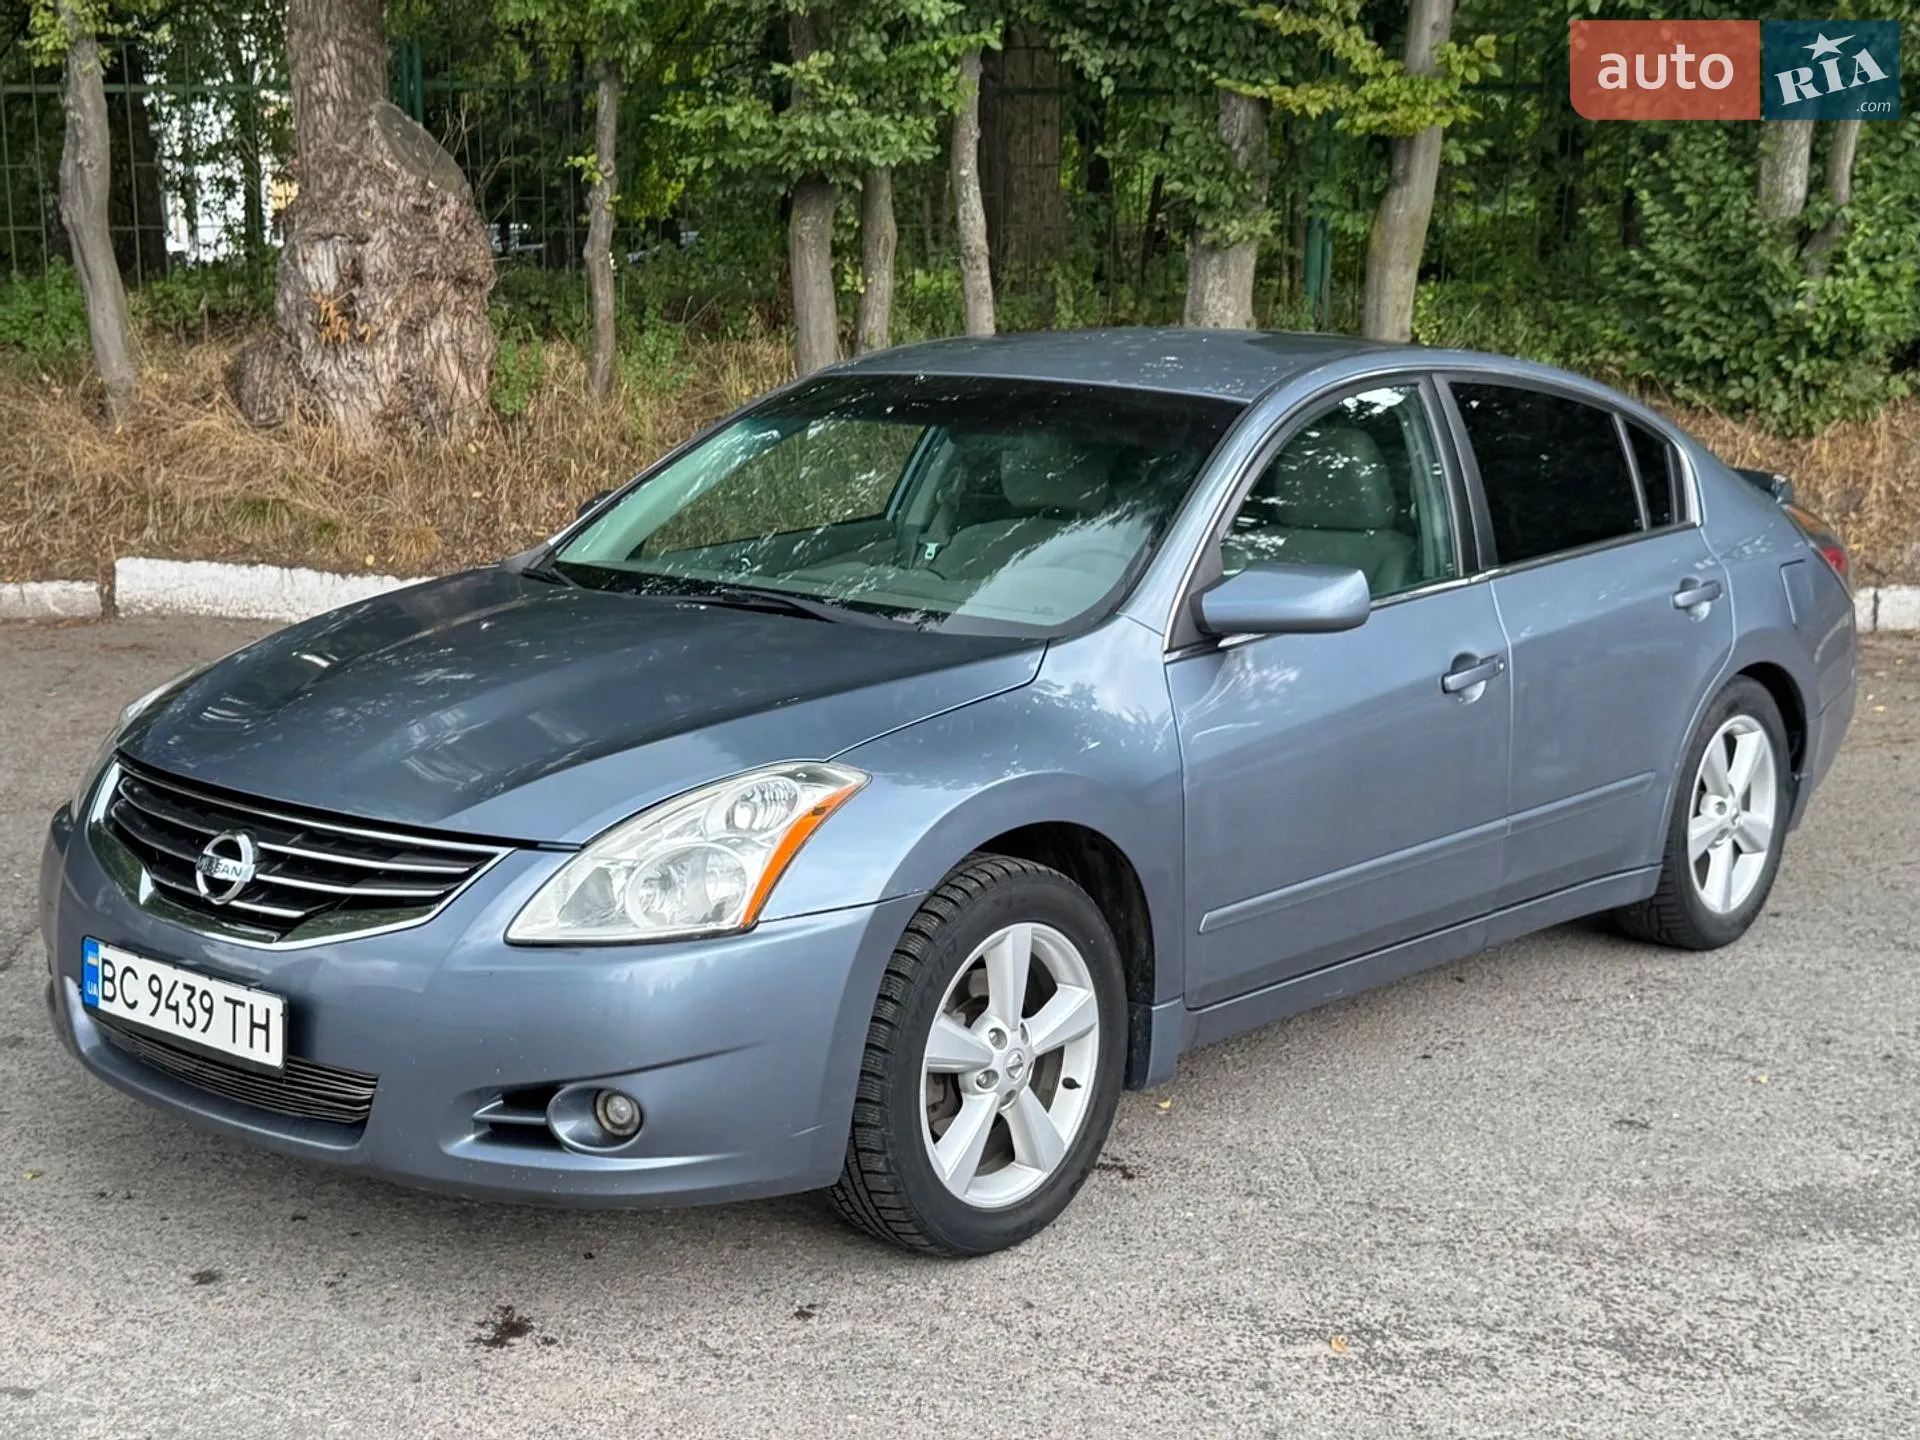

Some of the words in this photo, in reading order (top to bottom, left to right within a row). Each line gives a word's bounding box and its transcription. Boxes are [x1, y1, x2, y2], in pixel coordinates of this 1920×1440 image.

[86, 980, 98, 996] UA
[101, 958, 138, 1009] BC
[148, 974, 214, 1033] 9439
[224, 996, 270, 1053] TH
